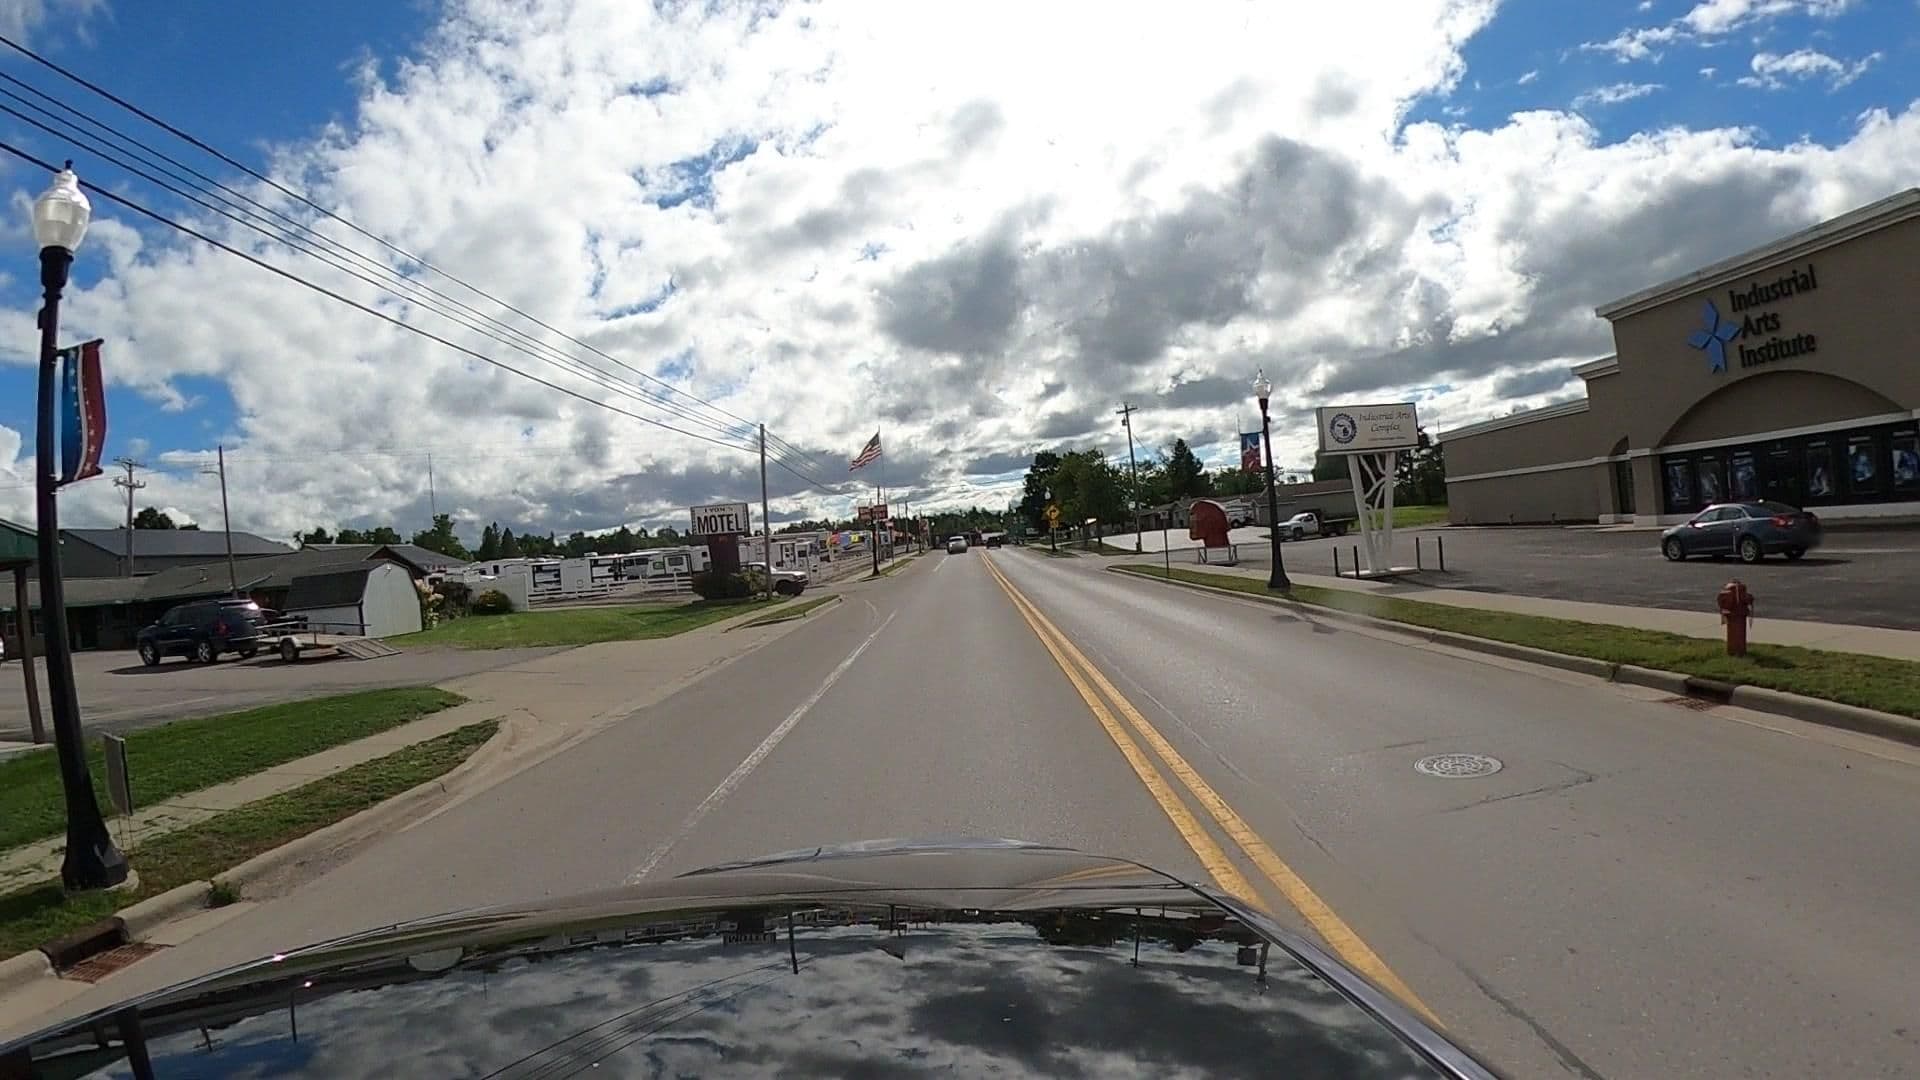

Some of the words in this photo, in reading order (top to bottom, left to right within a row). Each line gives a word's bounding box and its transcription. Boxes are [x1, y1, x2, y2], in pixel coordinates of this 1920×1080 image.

[1728, 264, 1817, 312] Industrial
[1741, 312, 1780, 339] Arts
[1738, 333, 1817, 368] Institute
[697, 513, 743, 533] MOTEL
